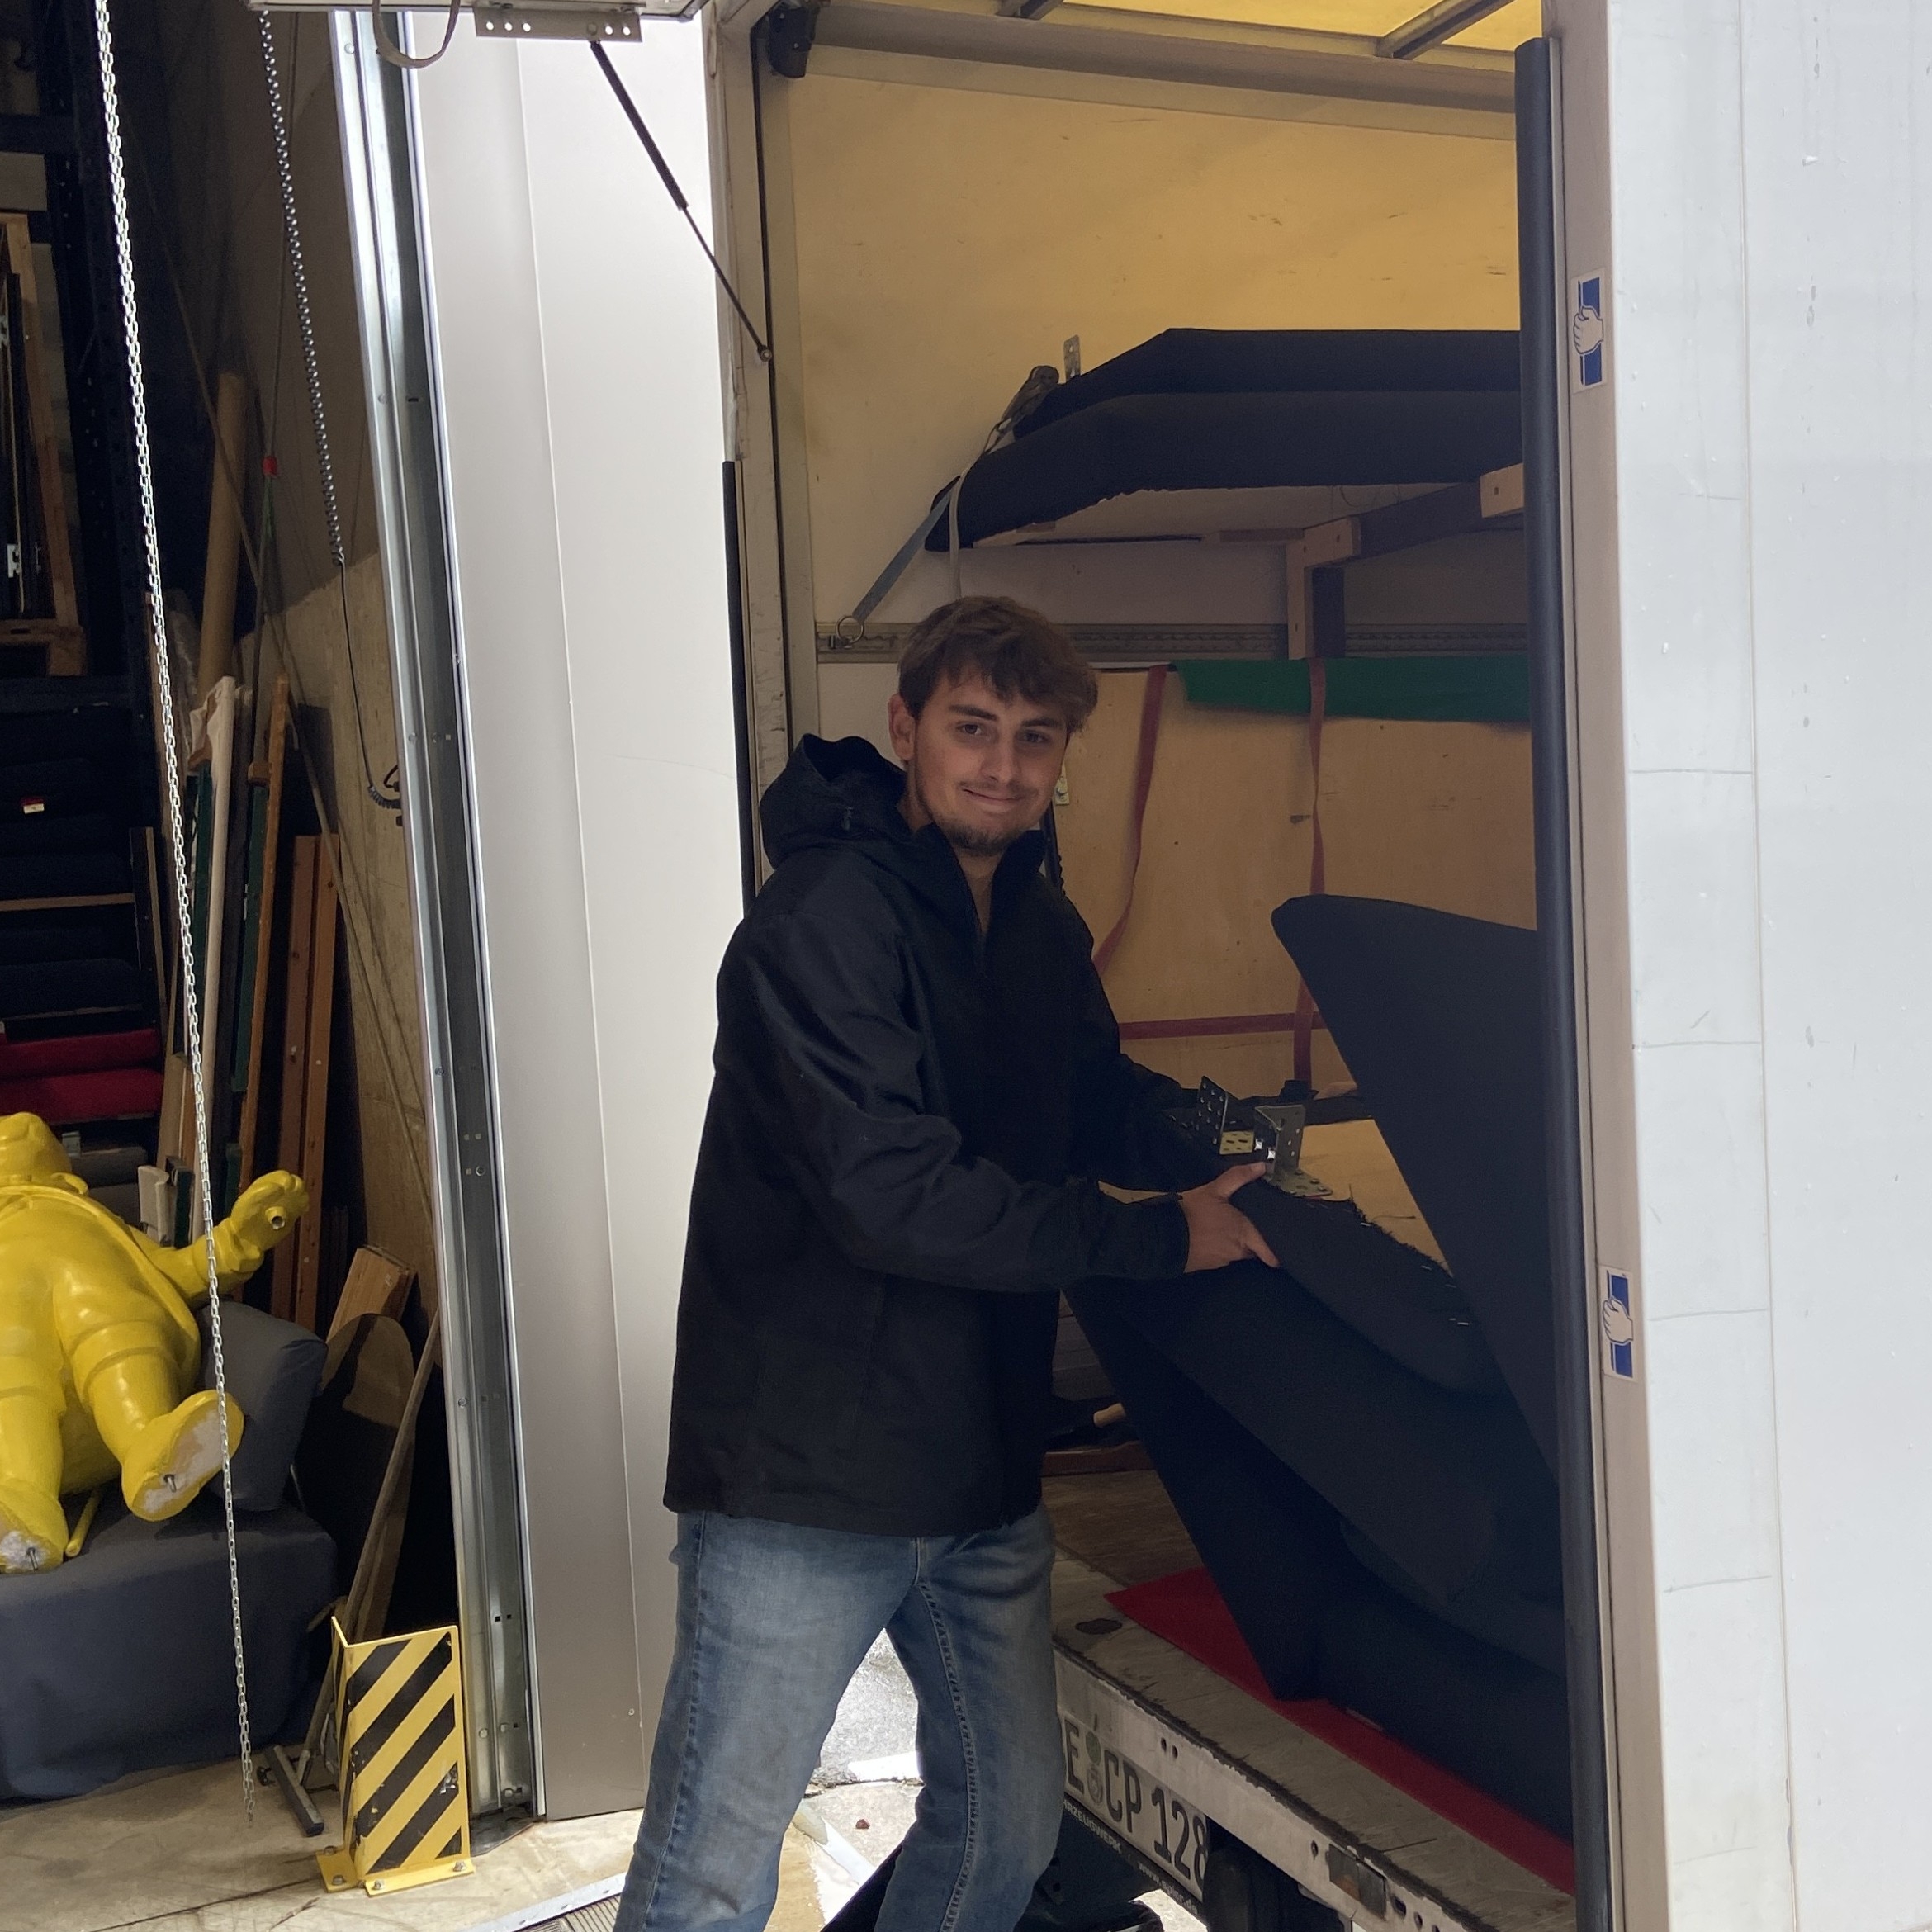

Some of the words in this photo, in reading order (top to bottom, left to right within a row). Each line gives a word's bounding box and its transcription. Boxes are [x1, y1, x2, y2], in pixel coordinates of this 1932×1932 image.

[1064, 1718, 1084, 1795] E
[1104, 1749, 1142, 1833] CP
[1151, 1787, 1207, 1892] 128
